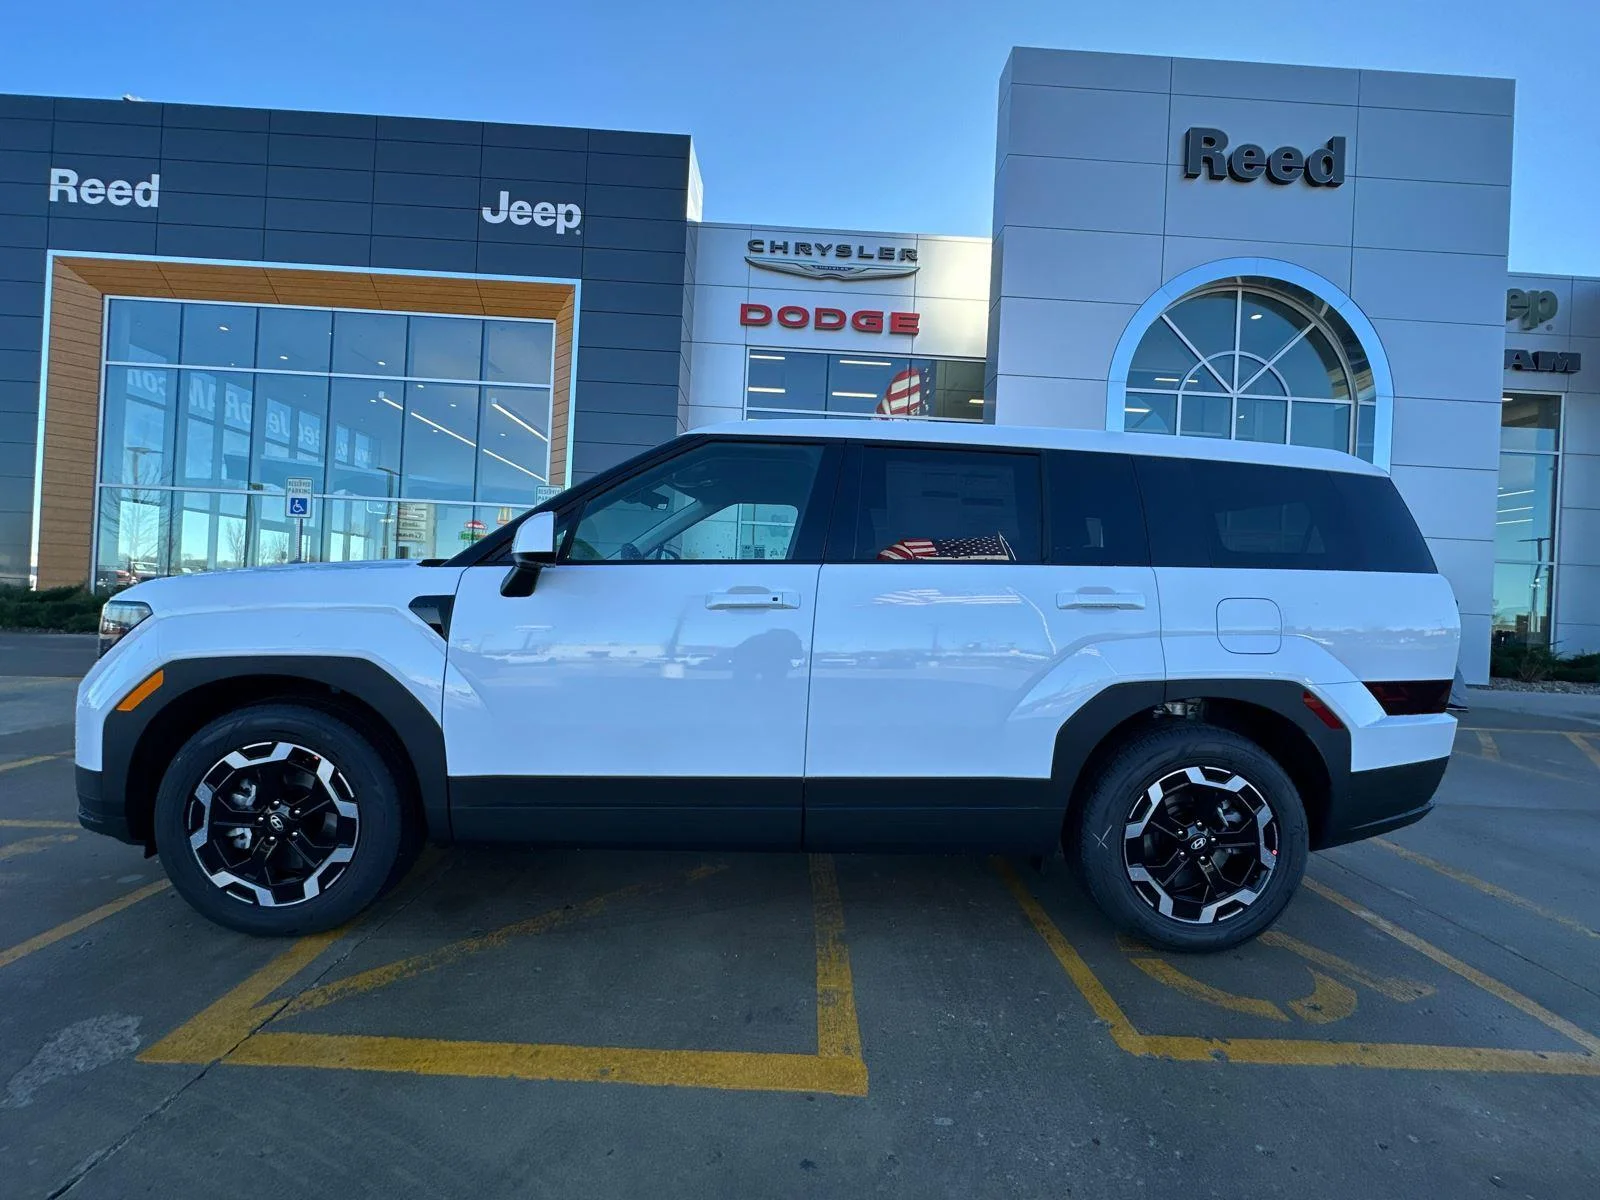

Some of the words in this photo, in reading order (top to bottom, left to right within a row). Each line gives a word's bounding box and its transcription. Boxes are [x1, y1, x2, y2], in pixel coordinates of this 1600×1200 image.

[1184, 127, 1346, 188] Reed
[49, 167, 160, 208] Reed
[482, 190, 582, 235] Jeep
[747, 239, 918, 262] CHRYSLER
[739, 303, 921, 336] DODGE
[1506, 288, 1558, 331] ep
[1504, 349, 1582, 374] AM
[287, 487, 311, 495] PARKING
